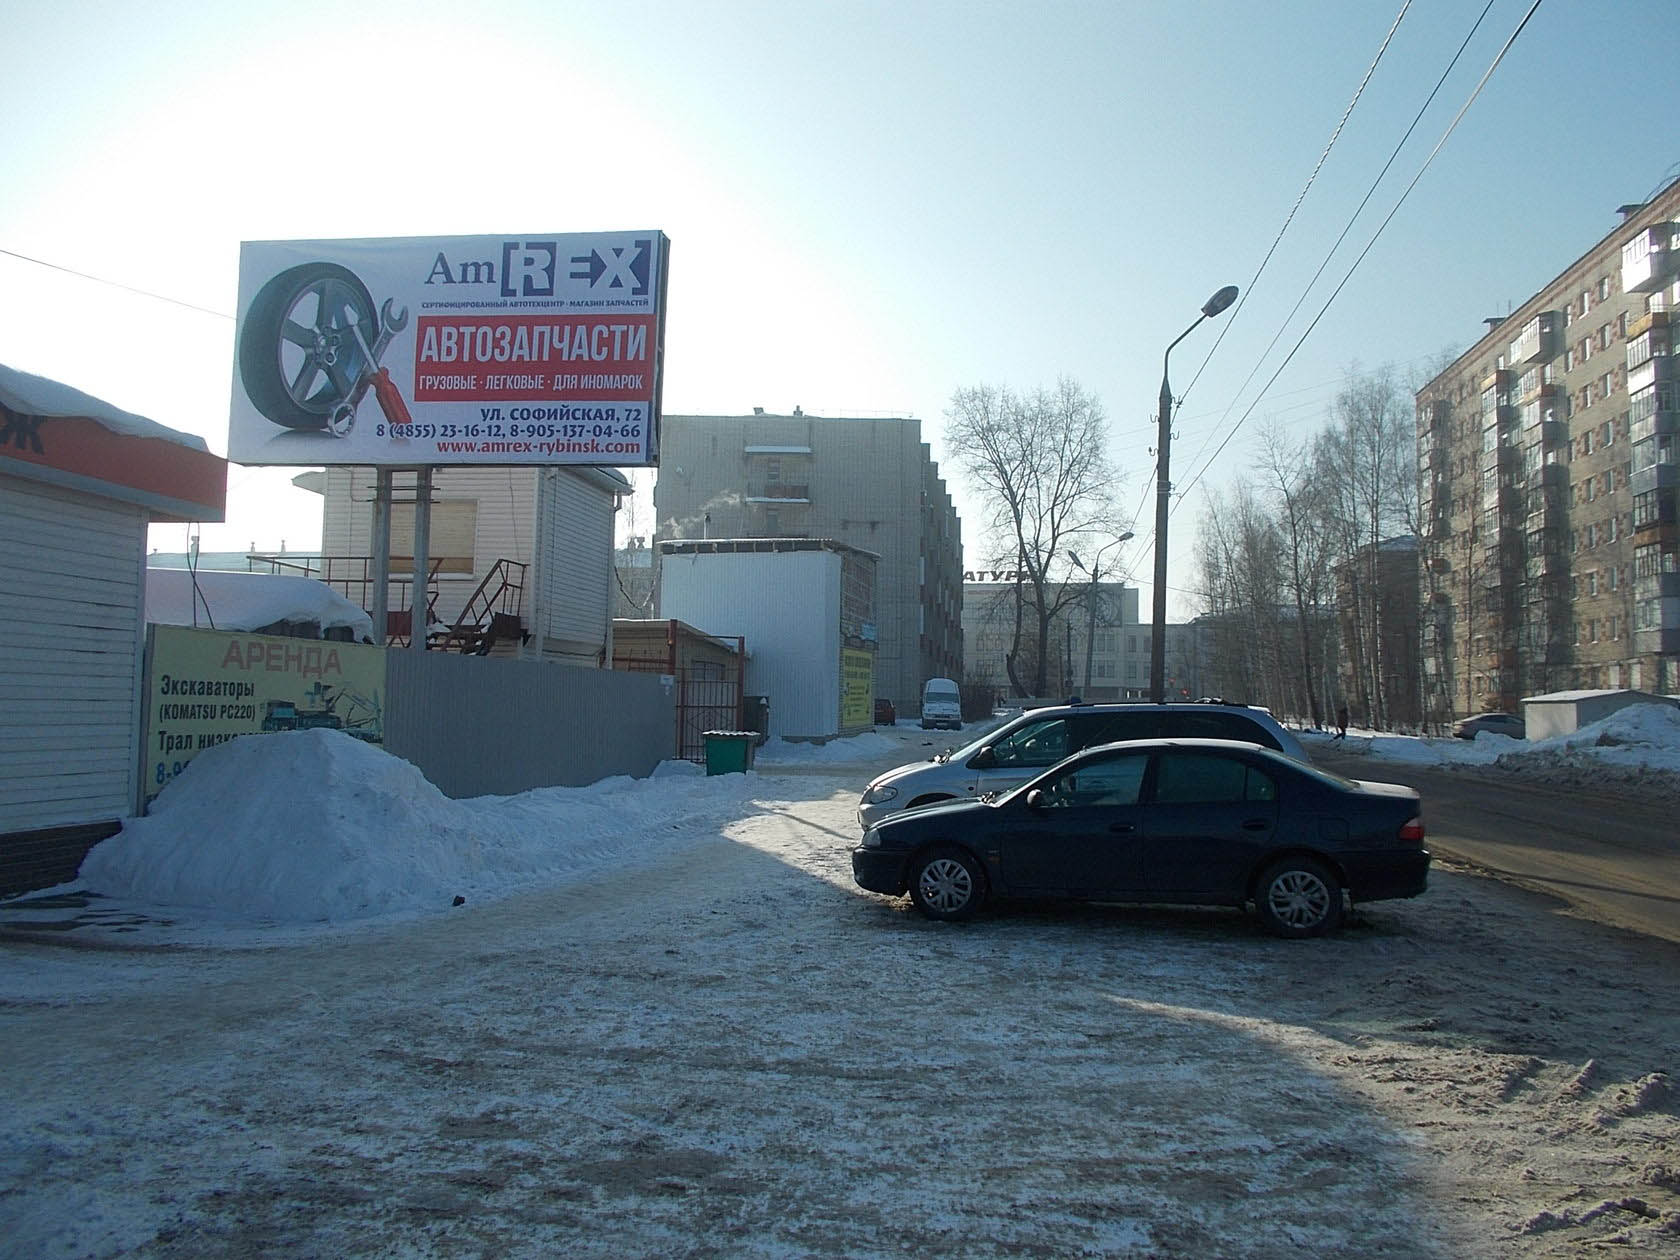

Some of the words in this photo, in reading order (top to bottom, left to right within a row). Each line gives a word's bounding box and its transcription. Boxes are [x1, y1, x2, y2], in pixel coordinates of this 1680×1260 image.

[422, 299, 509, 309] СЕРТИФИЦИРОВАННЫЙ
[509, 300, 565, 308] АВТОТЕХЦЕНТР
[569, 299, 604, 307] МАГАЗИН
[605, 299, 649, 307] ЗАПЧАСТЕЙ
[420, 324, 647, 362] АВТОЗАПЧАСТИ
[419, 375, 477, 390] ГРУЗОВЫЕ
[485, 374, 545, 389] ЛЕГКОВЫЕ
[553, 374, 578, 391] ДЛЯ
[581, 374, 643, 389] ИНОМАРОК
[481, 408, 505, 421] УЛ.
[509, 404, 620, 424] СОФИЙСКАЯ,
[625, 408, 642, 421] 72
[376, 425, 385, 436] 8
[389, 423, 436, 438] (4855)
[440, 424, 506, 439] 23-16-12,
[510, 424, 641, 438] 8-905-137-04-66
[437, 439, 641, 456] www.amrex-rybinsk.com
[221, 640, 342, 679] АРЕНДА
[161, 675, 255, 699] Экскаваторы
[159, 703, 216, 722] (KOMATSU
[220, 704, 256, 722] PC220)
[158, 731, 193, 754] Трал
